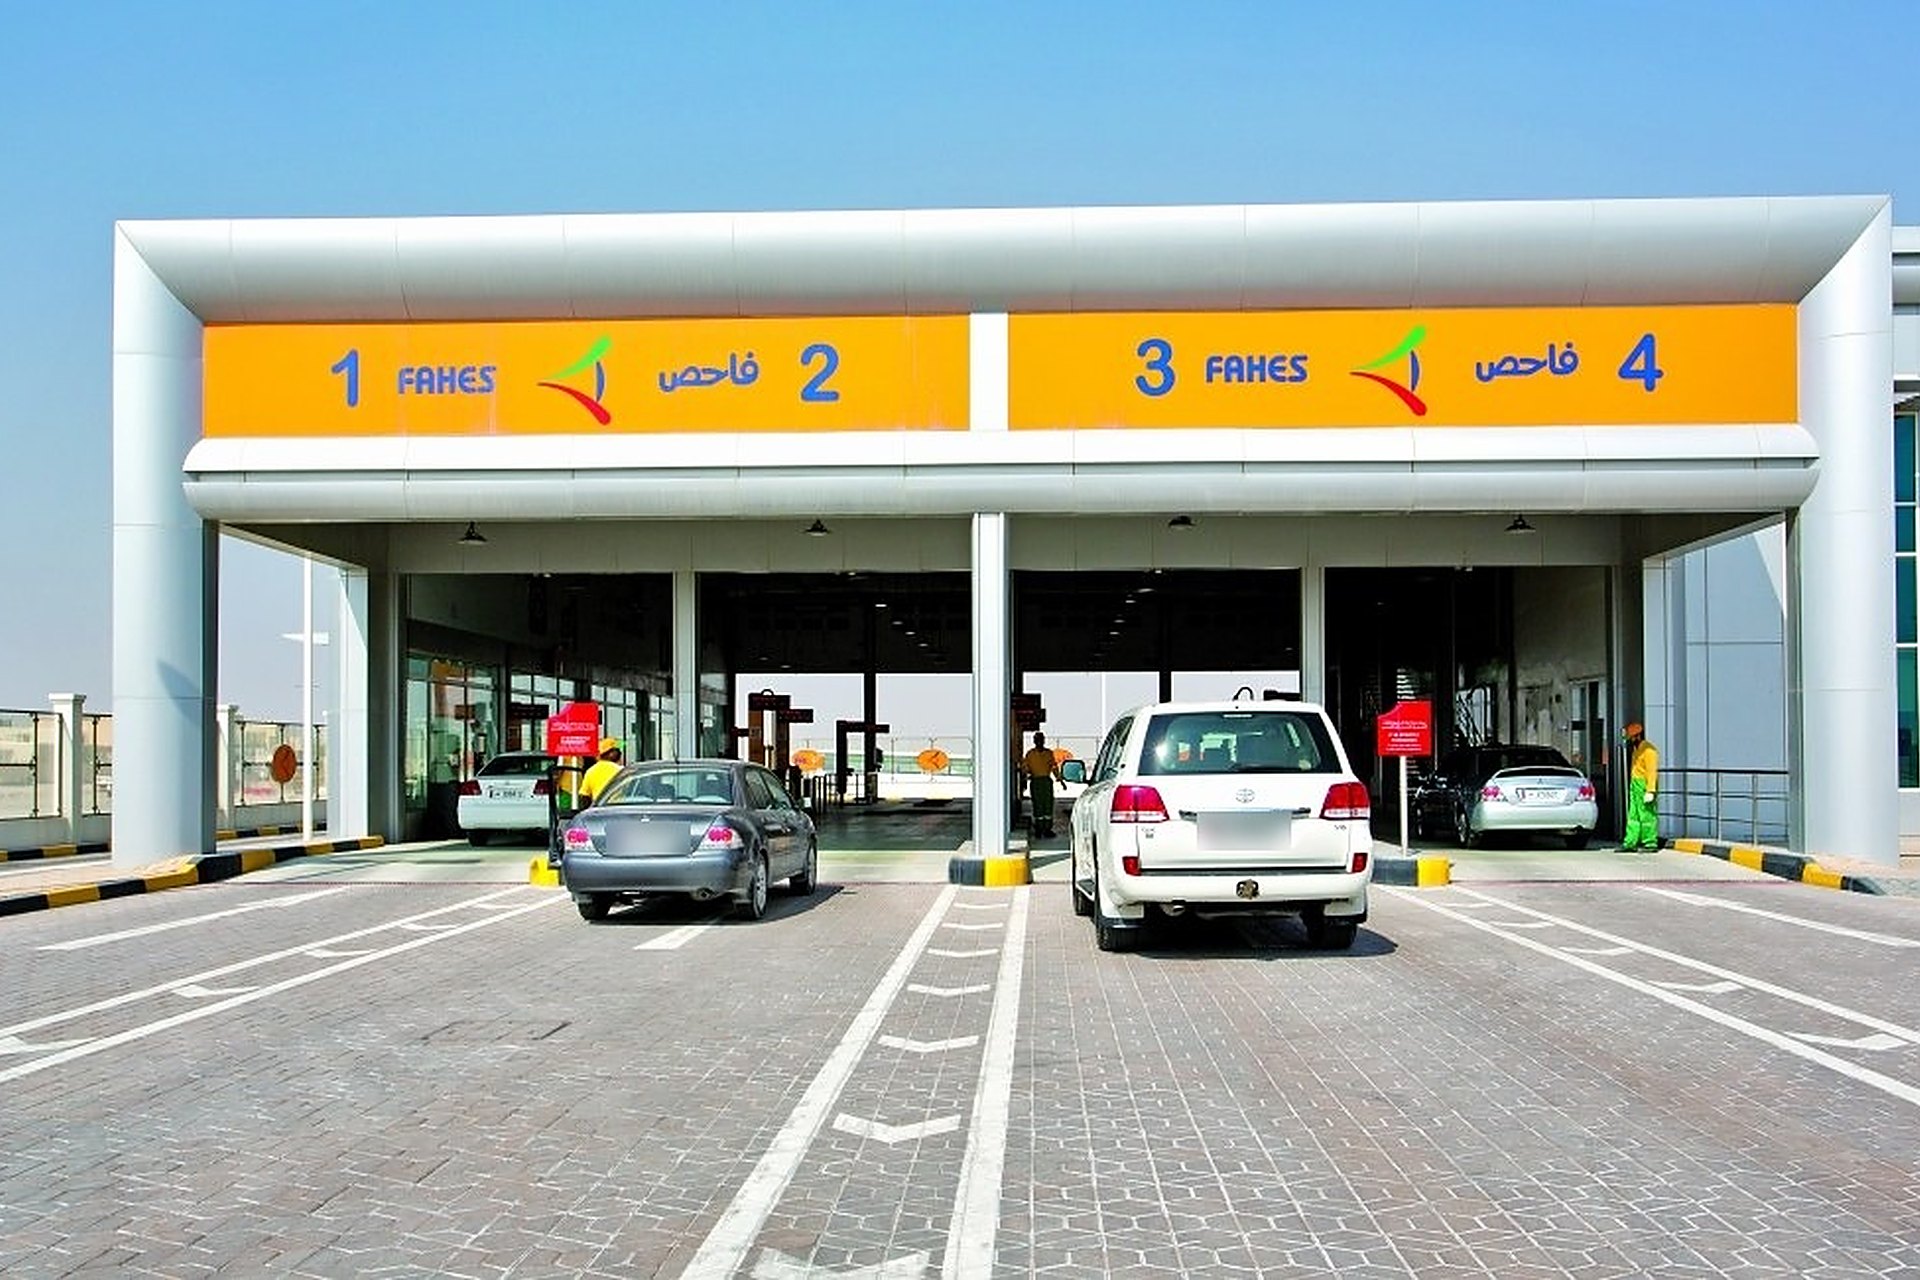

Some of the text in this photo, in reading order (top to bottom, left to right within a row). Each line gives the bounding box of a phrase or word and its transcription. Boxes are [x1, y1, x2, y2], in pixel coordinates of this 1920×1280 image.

[331, 350, 360, 407] 1
[398, 365, 497, 394] FAHES
[659, 351, 759, 393] فاحص
[800, 344, 840, 402] 2
[1135, 338, 1176, 397] 3
[1205, 355, 1309, 383] FAHES
[1475, 341, 1580, 382] فاحص
[1618, 334, 1663, 391] 4
